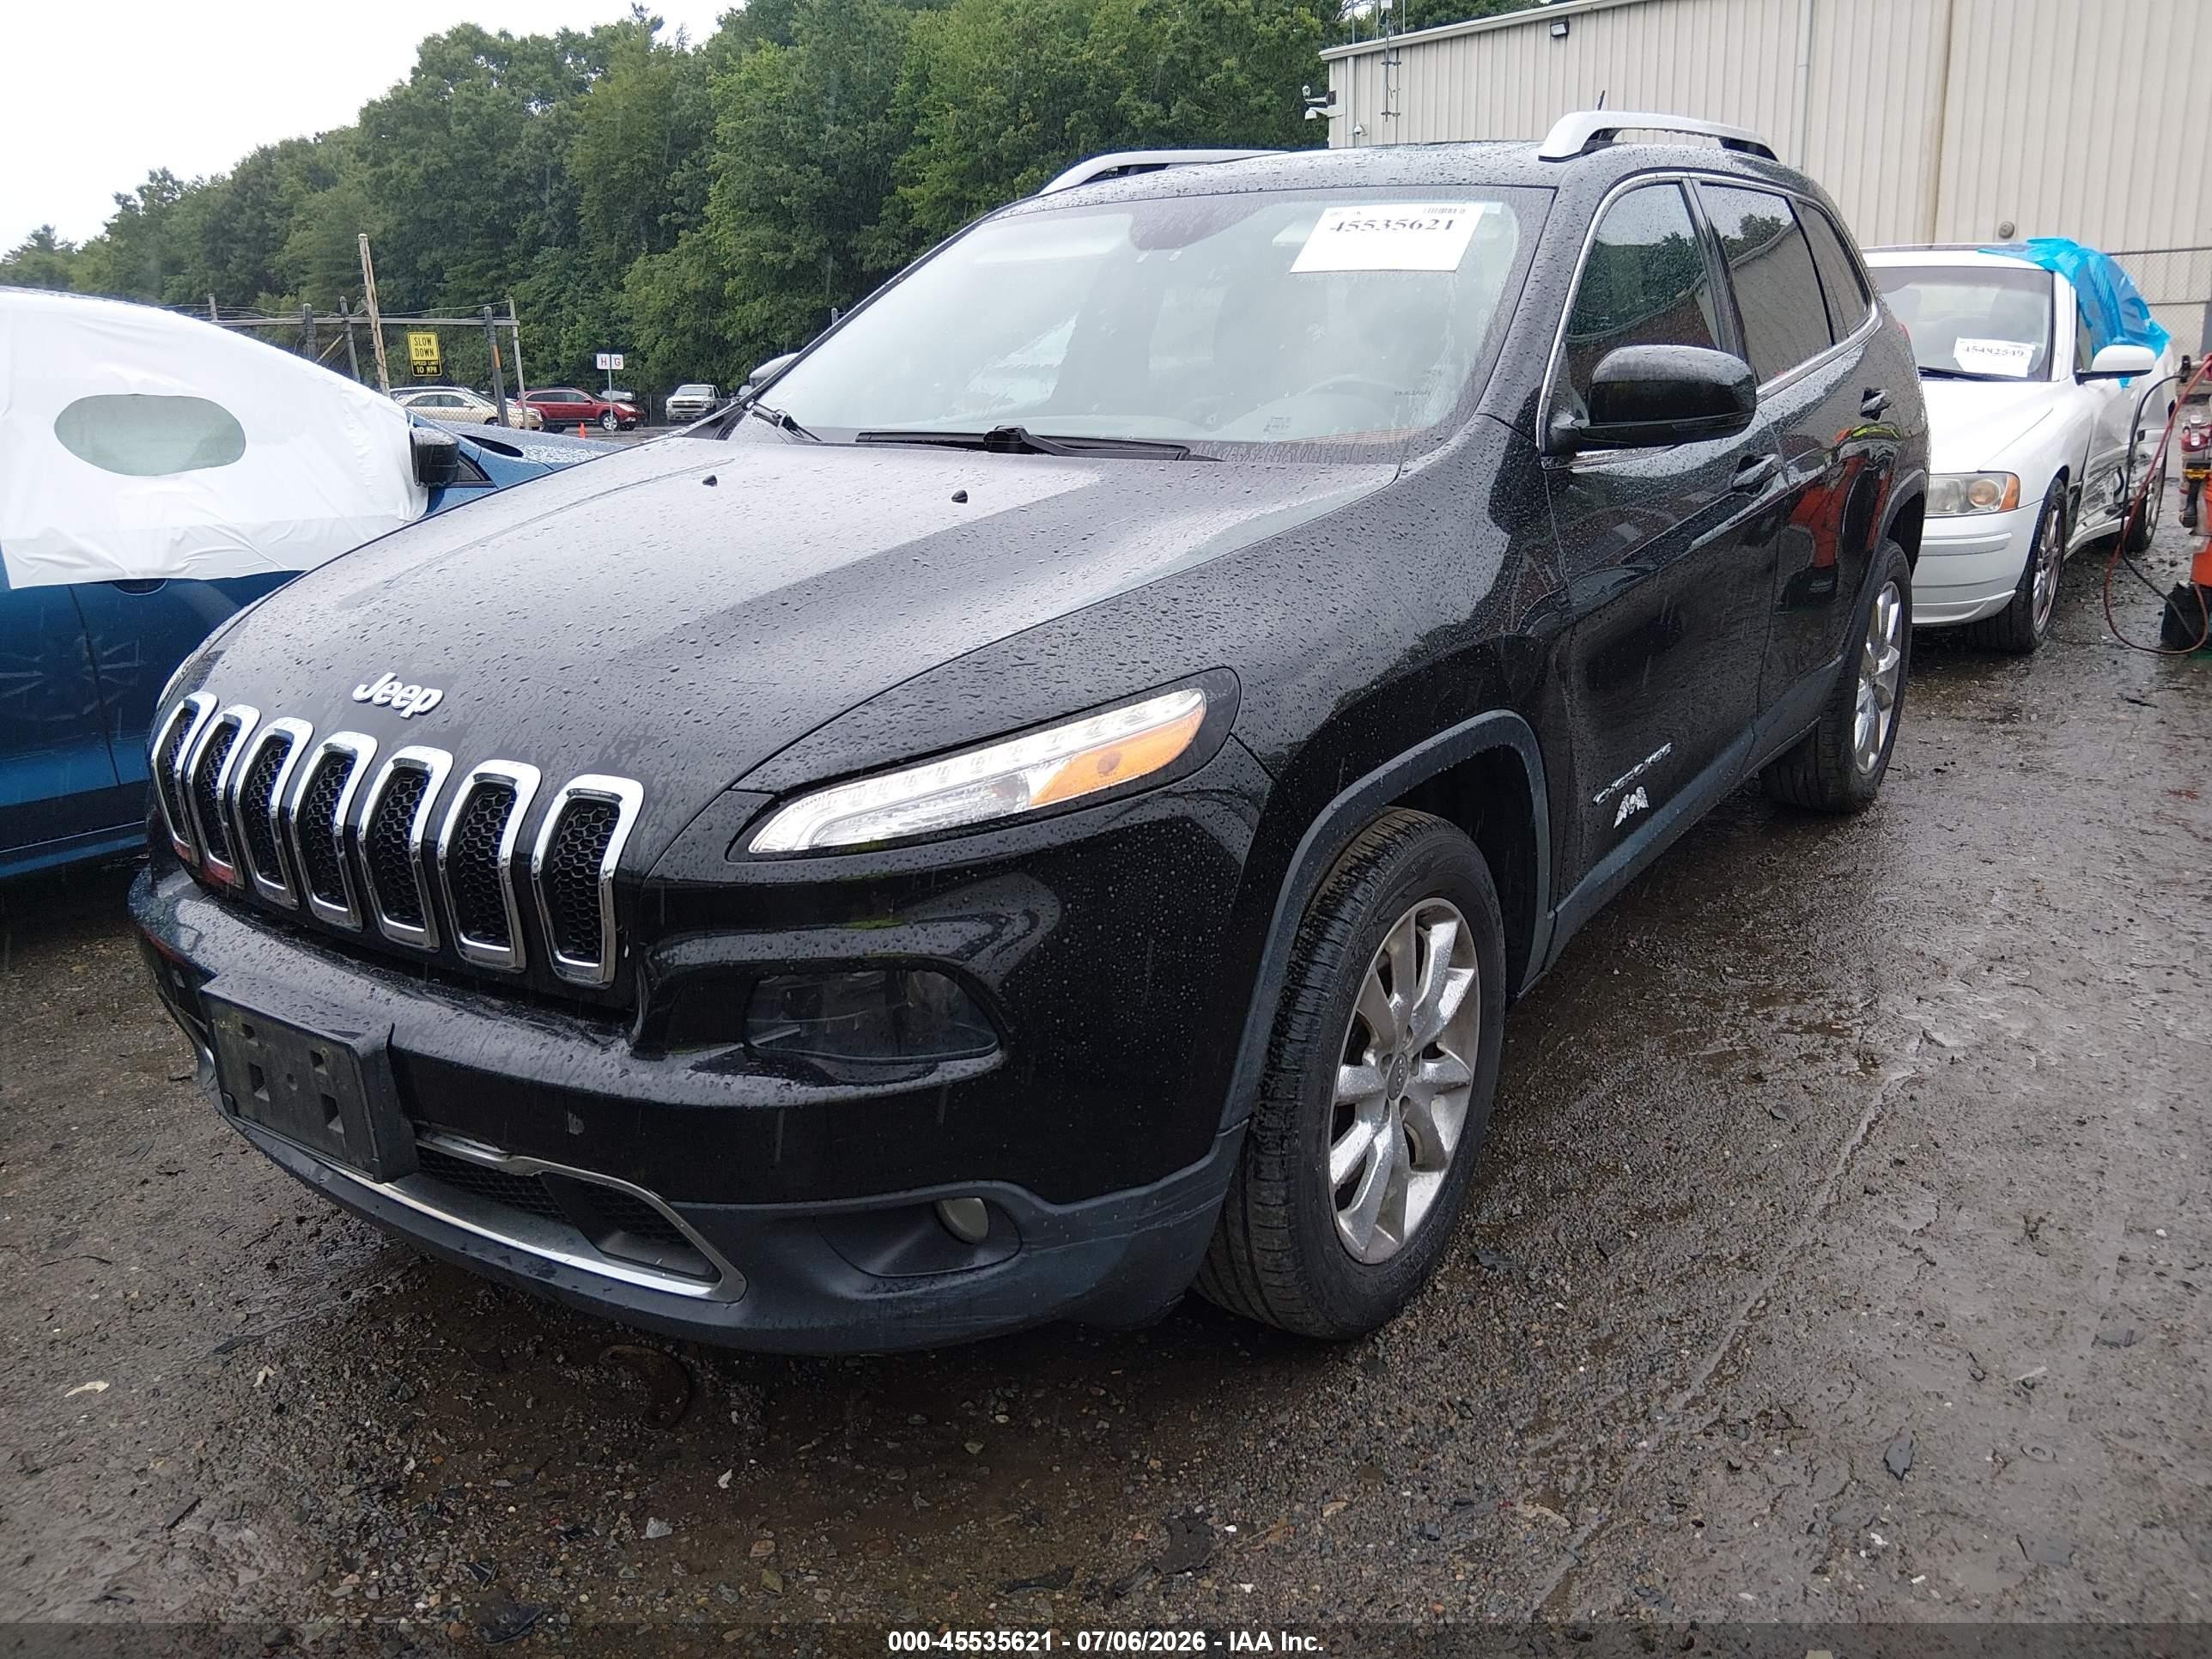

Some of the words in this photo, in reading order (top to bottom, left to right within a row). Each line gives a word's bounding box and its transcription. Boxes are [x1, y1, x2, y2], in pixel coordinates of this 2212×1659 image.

[1330, 219, 1455, 232] 45535621
[414, 337, 432, 347] SLOW
[415, 348, 434, 358] DOWN
[601, 356, 607, 366] H
[614, 357, 621, 366] G
[416, 366, 425, 374] 10
[352, 672, 444, 720] Jeep
